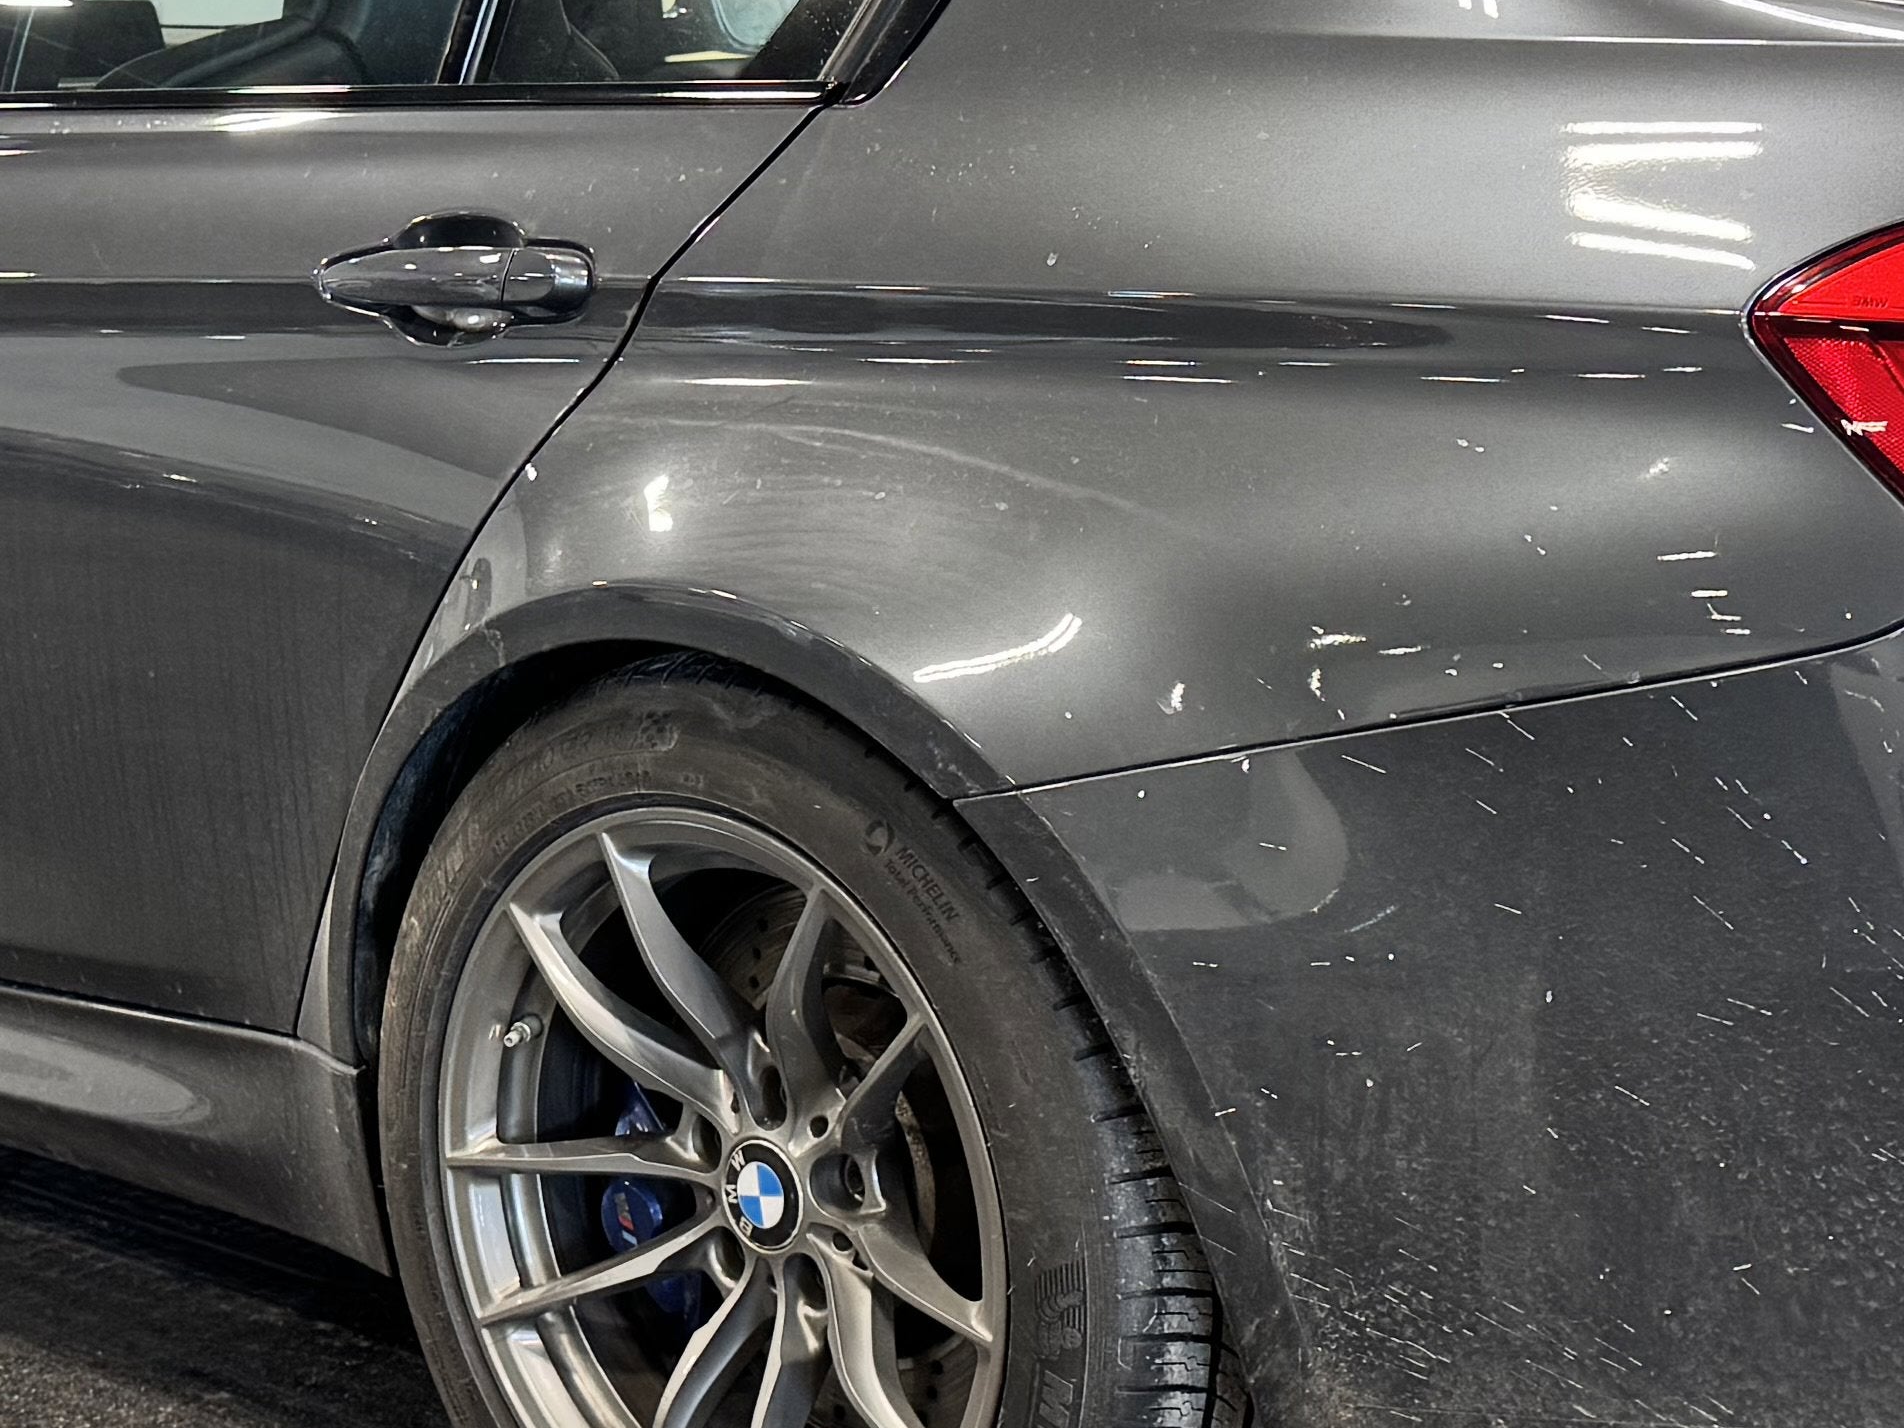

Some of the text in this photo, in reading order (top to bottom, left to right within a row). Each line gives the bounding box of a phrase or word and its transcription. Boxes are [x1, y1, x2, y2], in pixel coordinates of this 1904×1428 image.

[884, 858, 913, 889] Total
[896, 847, 960, 921] MICHELIN
[724, 1149, 754, 1237] BMW
